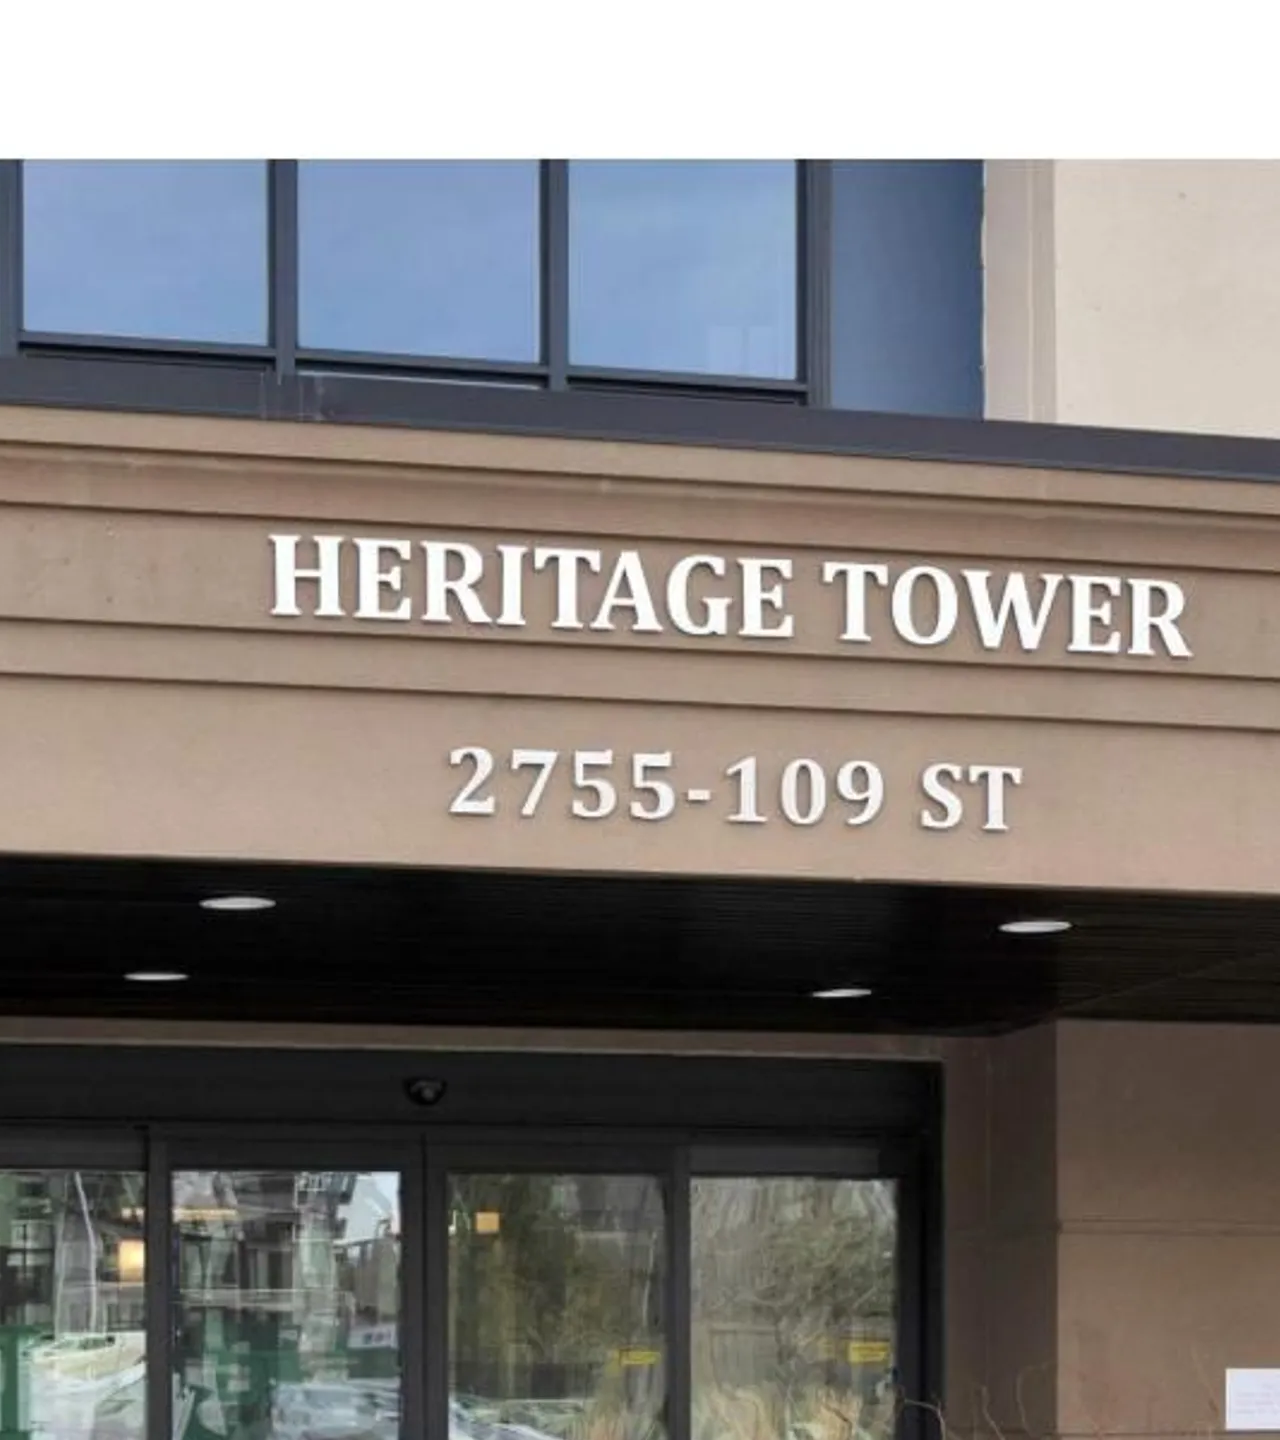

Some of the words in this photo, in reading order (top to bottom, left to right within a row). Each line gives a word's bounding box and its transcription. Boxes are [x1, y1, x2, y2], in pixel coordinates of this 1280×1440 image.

[269, 534, 794, 637] HERITAGE
[824, 561, 1192, 657] TOWER
[449, 747, 884, 826] 2755-109
[921, 763, 1022, 830] ST
